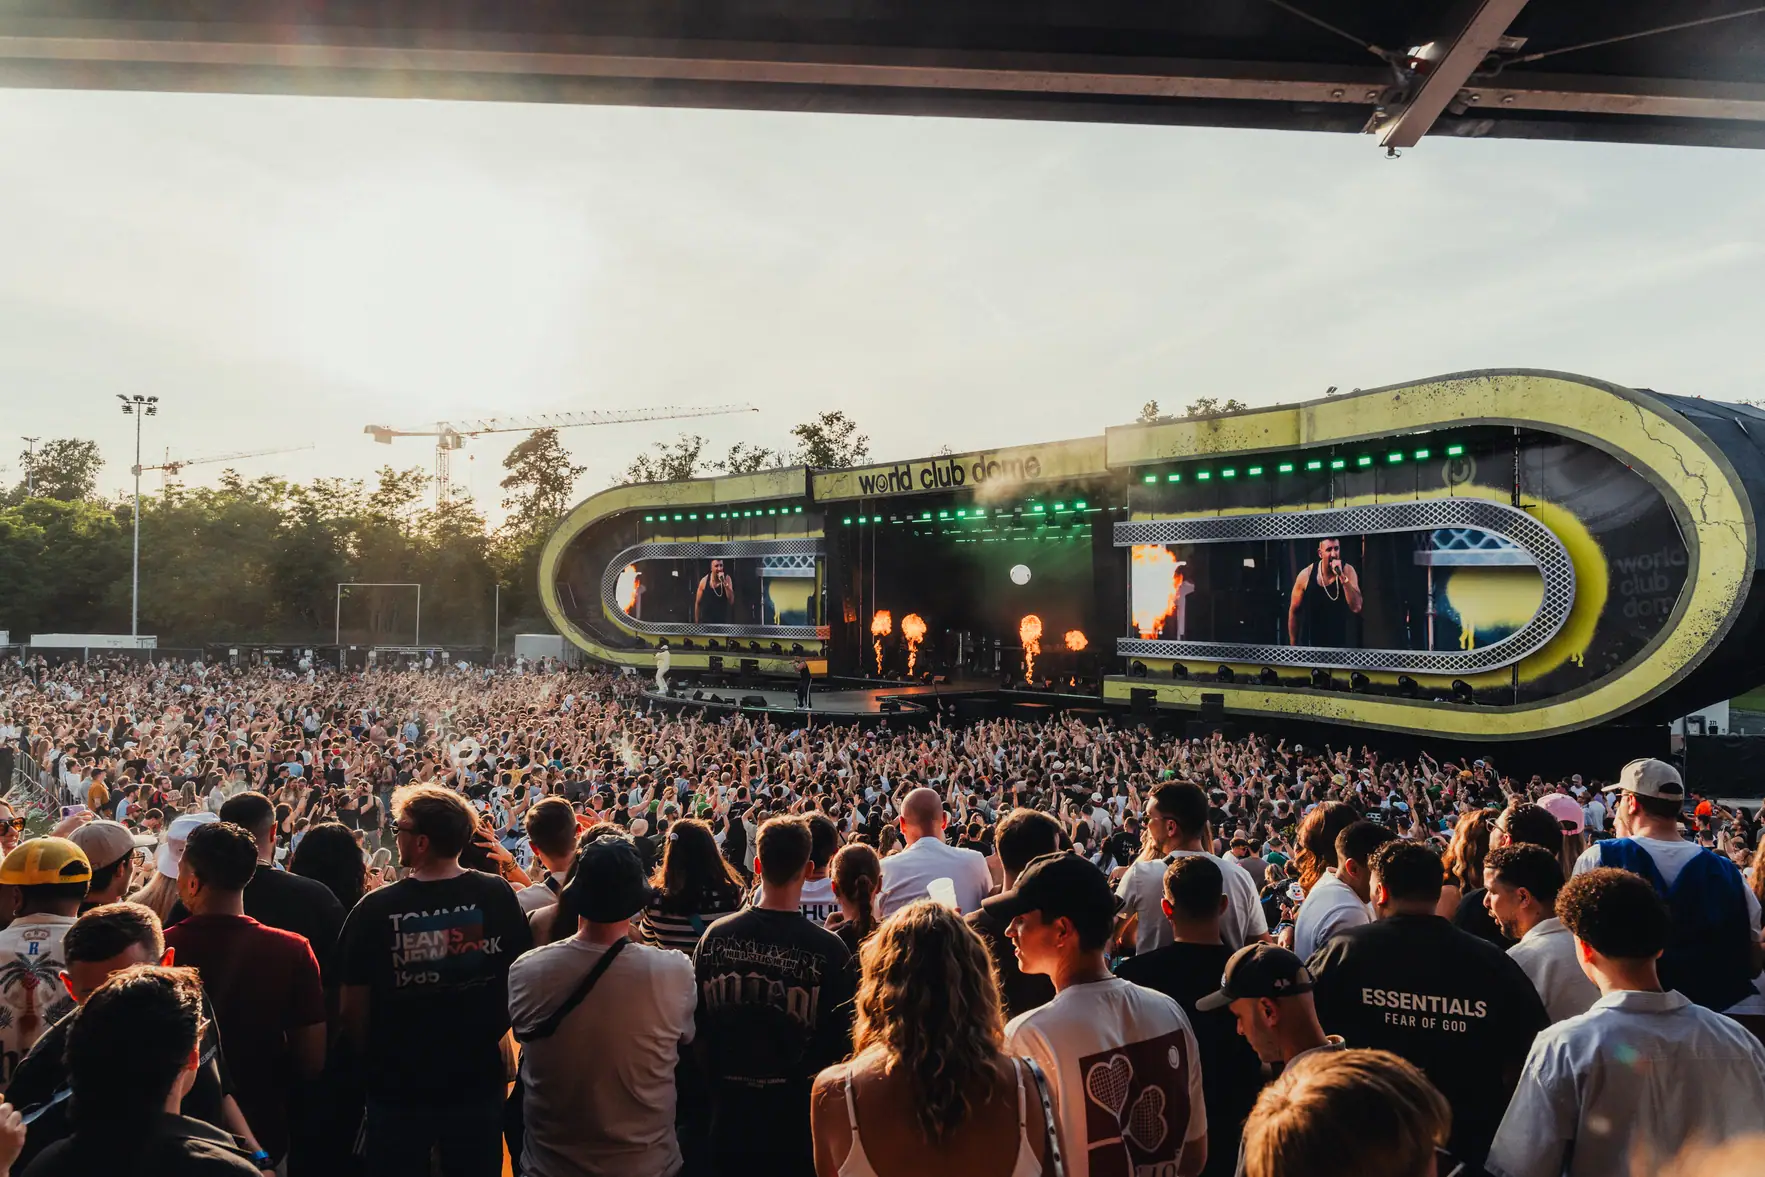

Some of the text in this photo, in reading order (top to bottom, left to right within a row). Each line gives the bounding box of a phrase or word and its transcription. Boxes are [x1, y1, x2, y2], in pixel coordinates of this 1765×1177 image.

[858, 455, 1041, 495] world club dome
[1612, 546, 1686, 574] world
[1620, 570, 1669, 596] club
[1623, 596, 1675, 618] dom
[390, 927, 465, 951] JEANS
[391, 946, 448, 968] NEW
[1361, 987, 1487, 1018] ESSENTIALS
[1384, 1012, 1467, 1033] FEAR OF GOD
